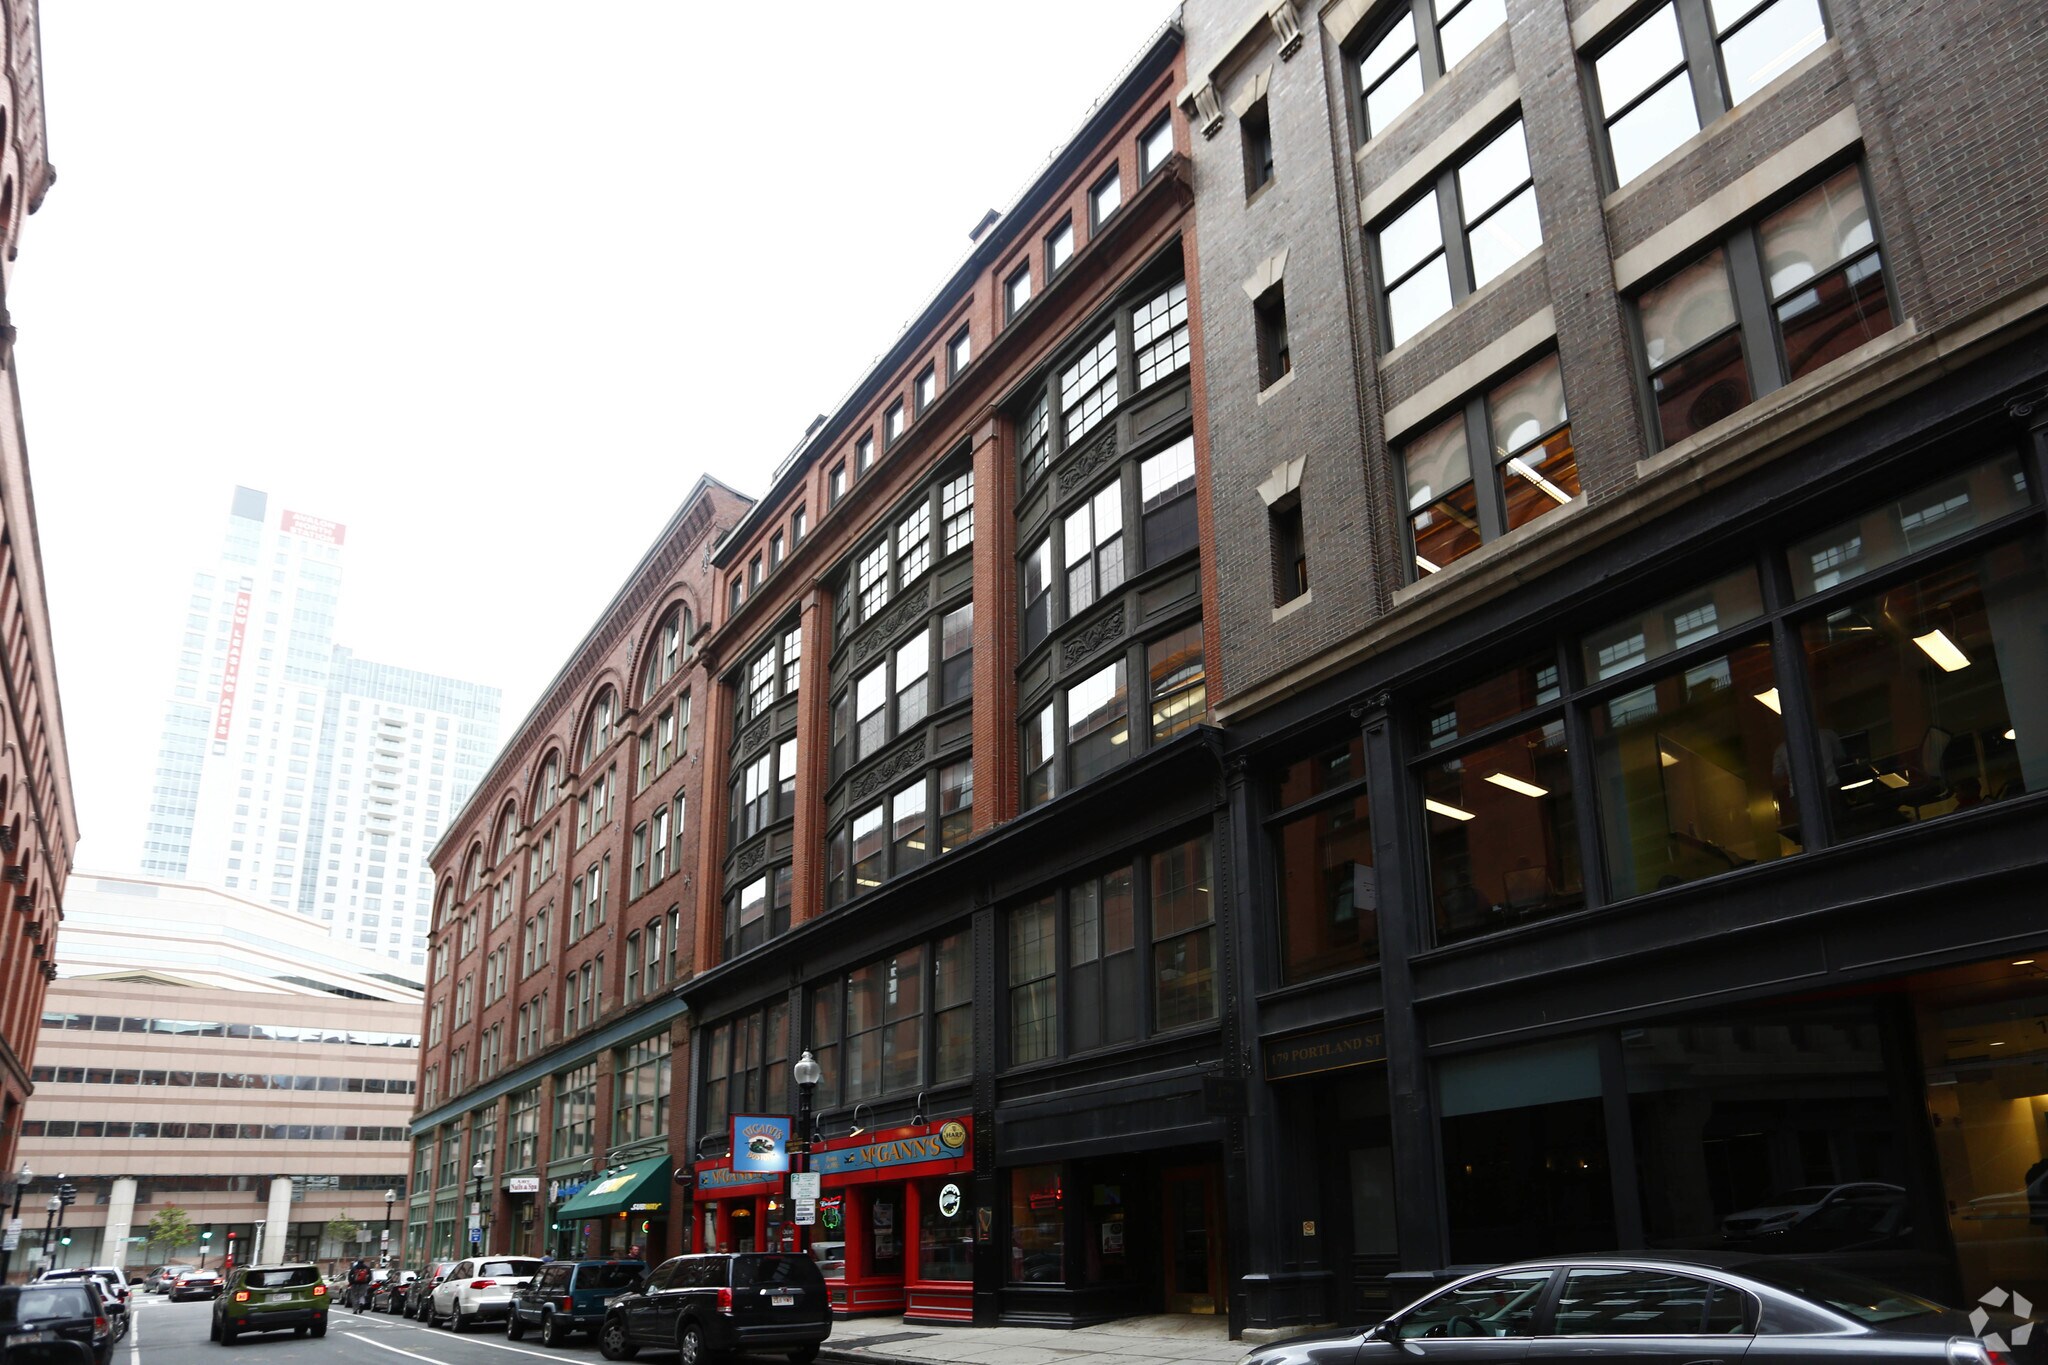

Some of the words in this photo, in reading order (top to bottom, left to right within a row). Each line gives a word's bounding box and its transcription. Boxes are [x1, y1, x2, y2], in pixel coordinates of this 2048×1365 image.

[292, 512, 336, 530] AVALON
[294, 520, 333, 536] NORTH
[290, 526, 336, 544] STATION
[234, 598, 248, 624] NOW
[224, 629, 242, 693] LEASING
[217, 698, 232, 734] APTS
[1271, 1052, 1289, 1065] 179
[1291, 1037, 1362, 1062] PORTLAND
[1365, 1032, 1383, 1047] ST
[946, 1131, 963, 1139] HARP
[630, 1203, 662, 1211] SUBWAY
